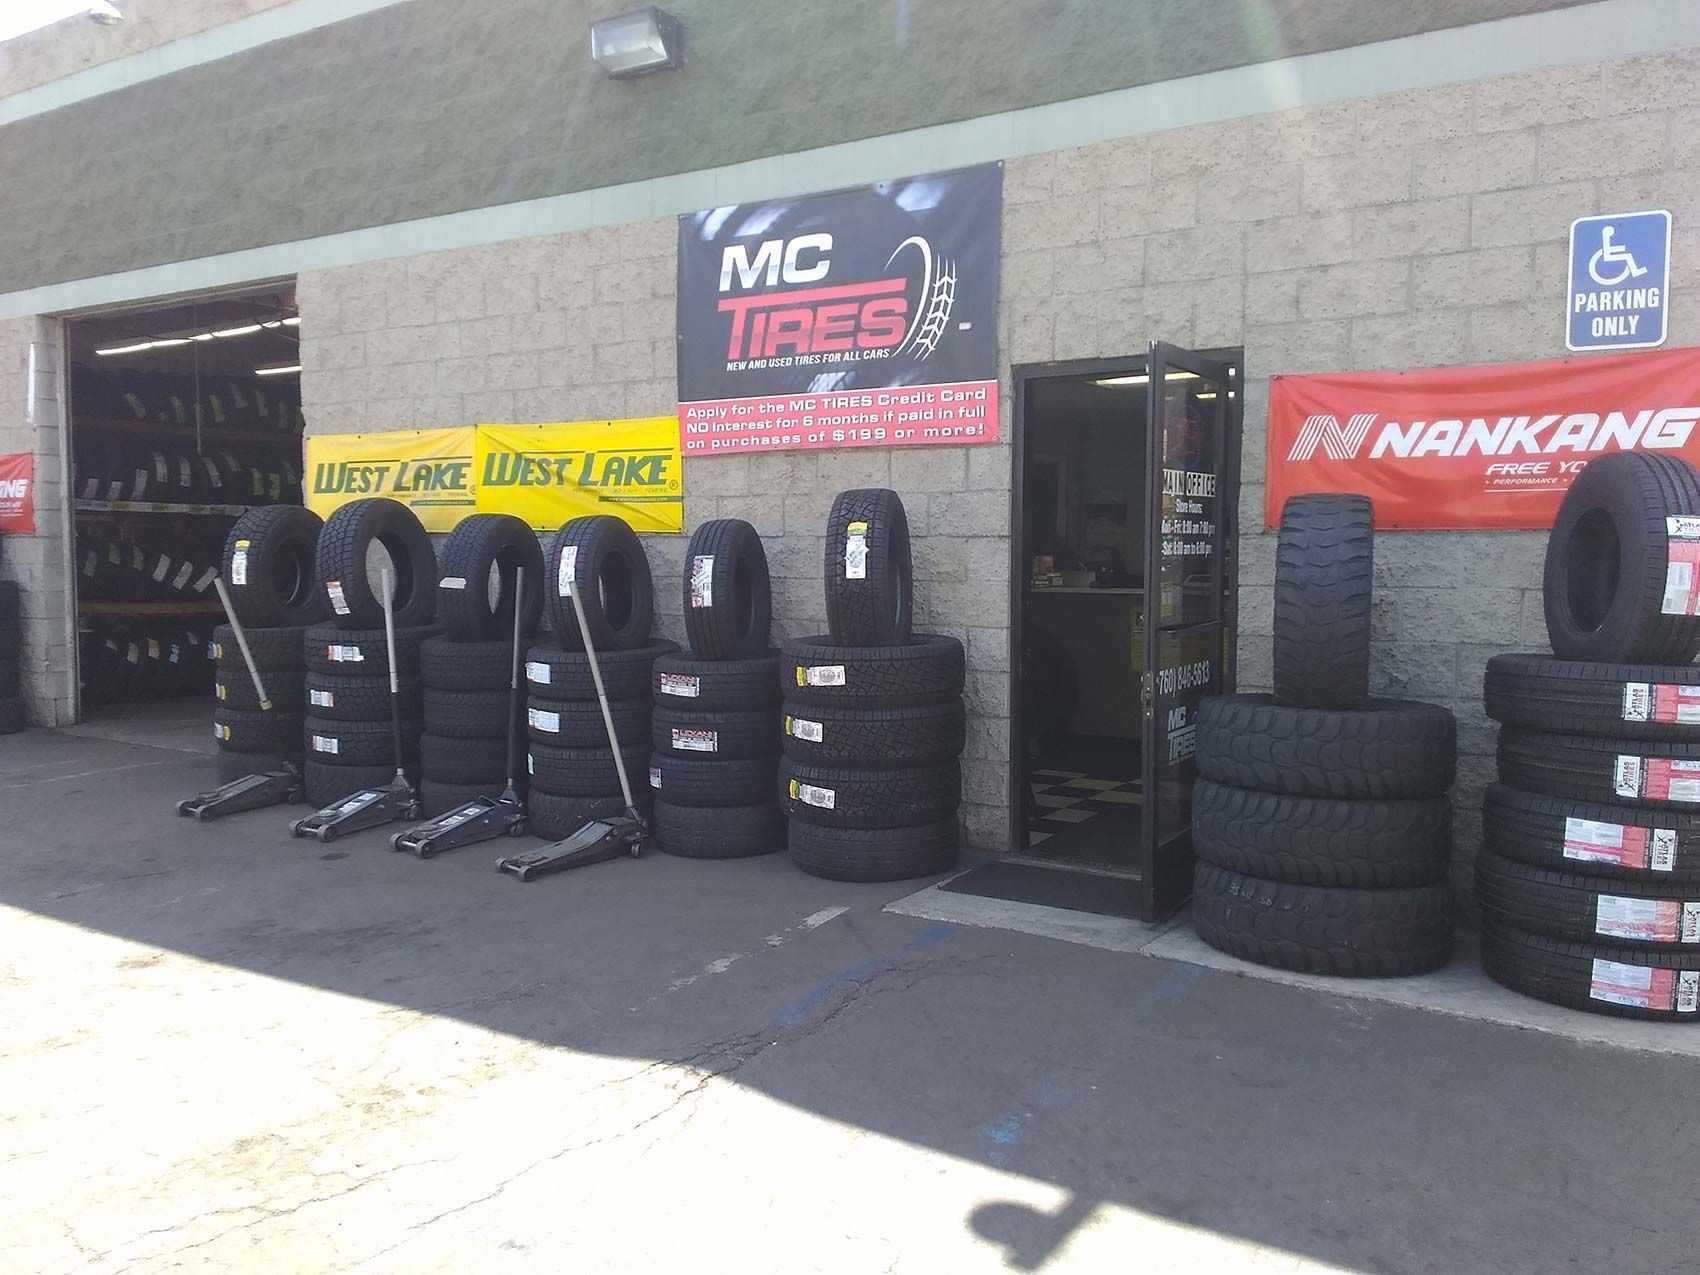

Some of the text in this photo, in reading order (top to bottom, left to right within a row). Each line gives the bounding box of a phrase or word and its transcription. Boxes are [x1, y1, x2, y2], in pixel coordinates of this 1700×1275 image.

[718, 233, 832, 291] MC
[1575, 287, 1660, 313] PARKING
[718, 278, 908, 360] TIRES
[1592, 315, 1640, 337] ONLY
[727, 348, 890, 372] NEW AND USED TIRES FOR ALL CARS
[686, 388, 987, 420] Apply for the MC TIRES Credit Card
[686, 405, 985, 434] NO Interest for 6 months if paid in full
[1369, 406, 1700, 459] NANKANG
[686, 422, 985, 450] on purchases of $199 or more!
[313, 457, 472, 494] WEST LAKE
[482, 449, 673, 487] WEST LAKE
[1485, 460, 1588, 476] FREE YO
[1186, 472, 1216, 497] OFFICE
[1168, 706, 1186, 731] MC
[1168, 724, 1196, 760] TIRES
